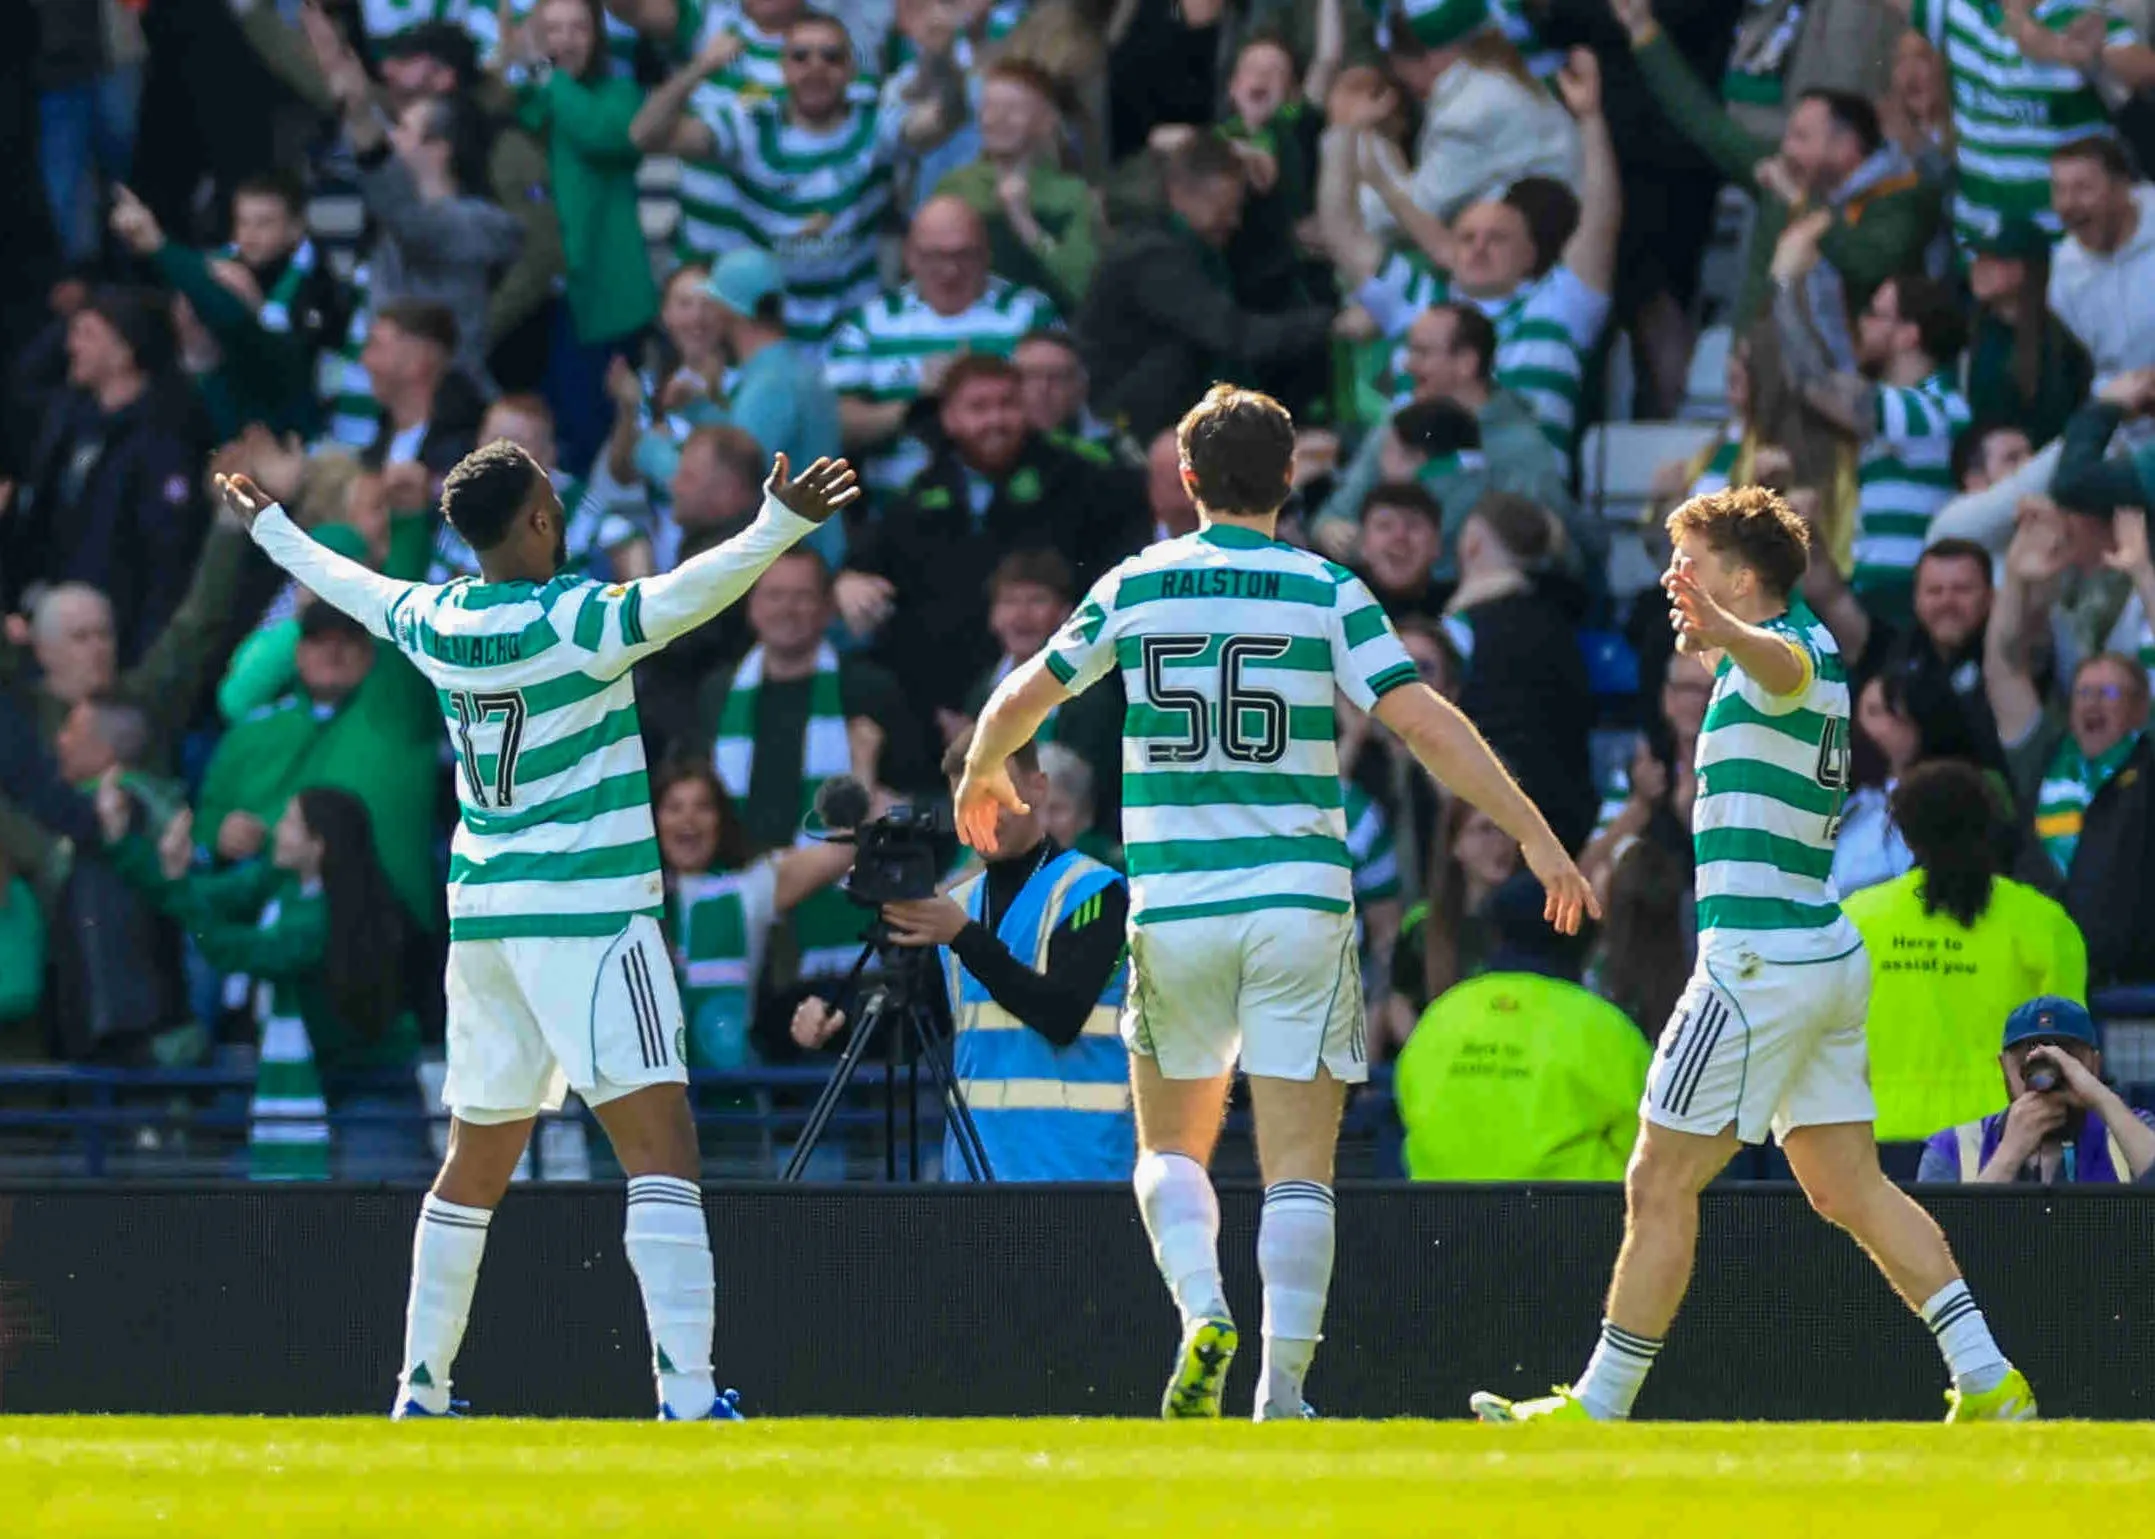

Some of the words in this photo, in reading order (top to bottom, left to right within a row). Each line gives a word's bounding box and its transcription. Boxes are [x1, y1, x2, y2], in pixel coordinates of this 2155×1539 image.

[1162, 567, 1280, 599] RALSTON
[1141, 633, 1292, 765] 56
[449, 687, 527, 808] 17
[1893, 936, 1937, 951] Here
[1944, 936, 1963, 951] to
[1881, 957, 1937, 971] assist
[1943, 960, 1977, 976] you
